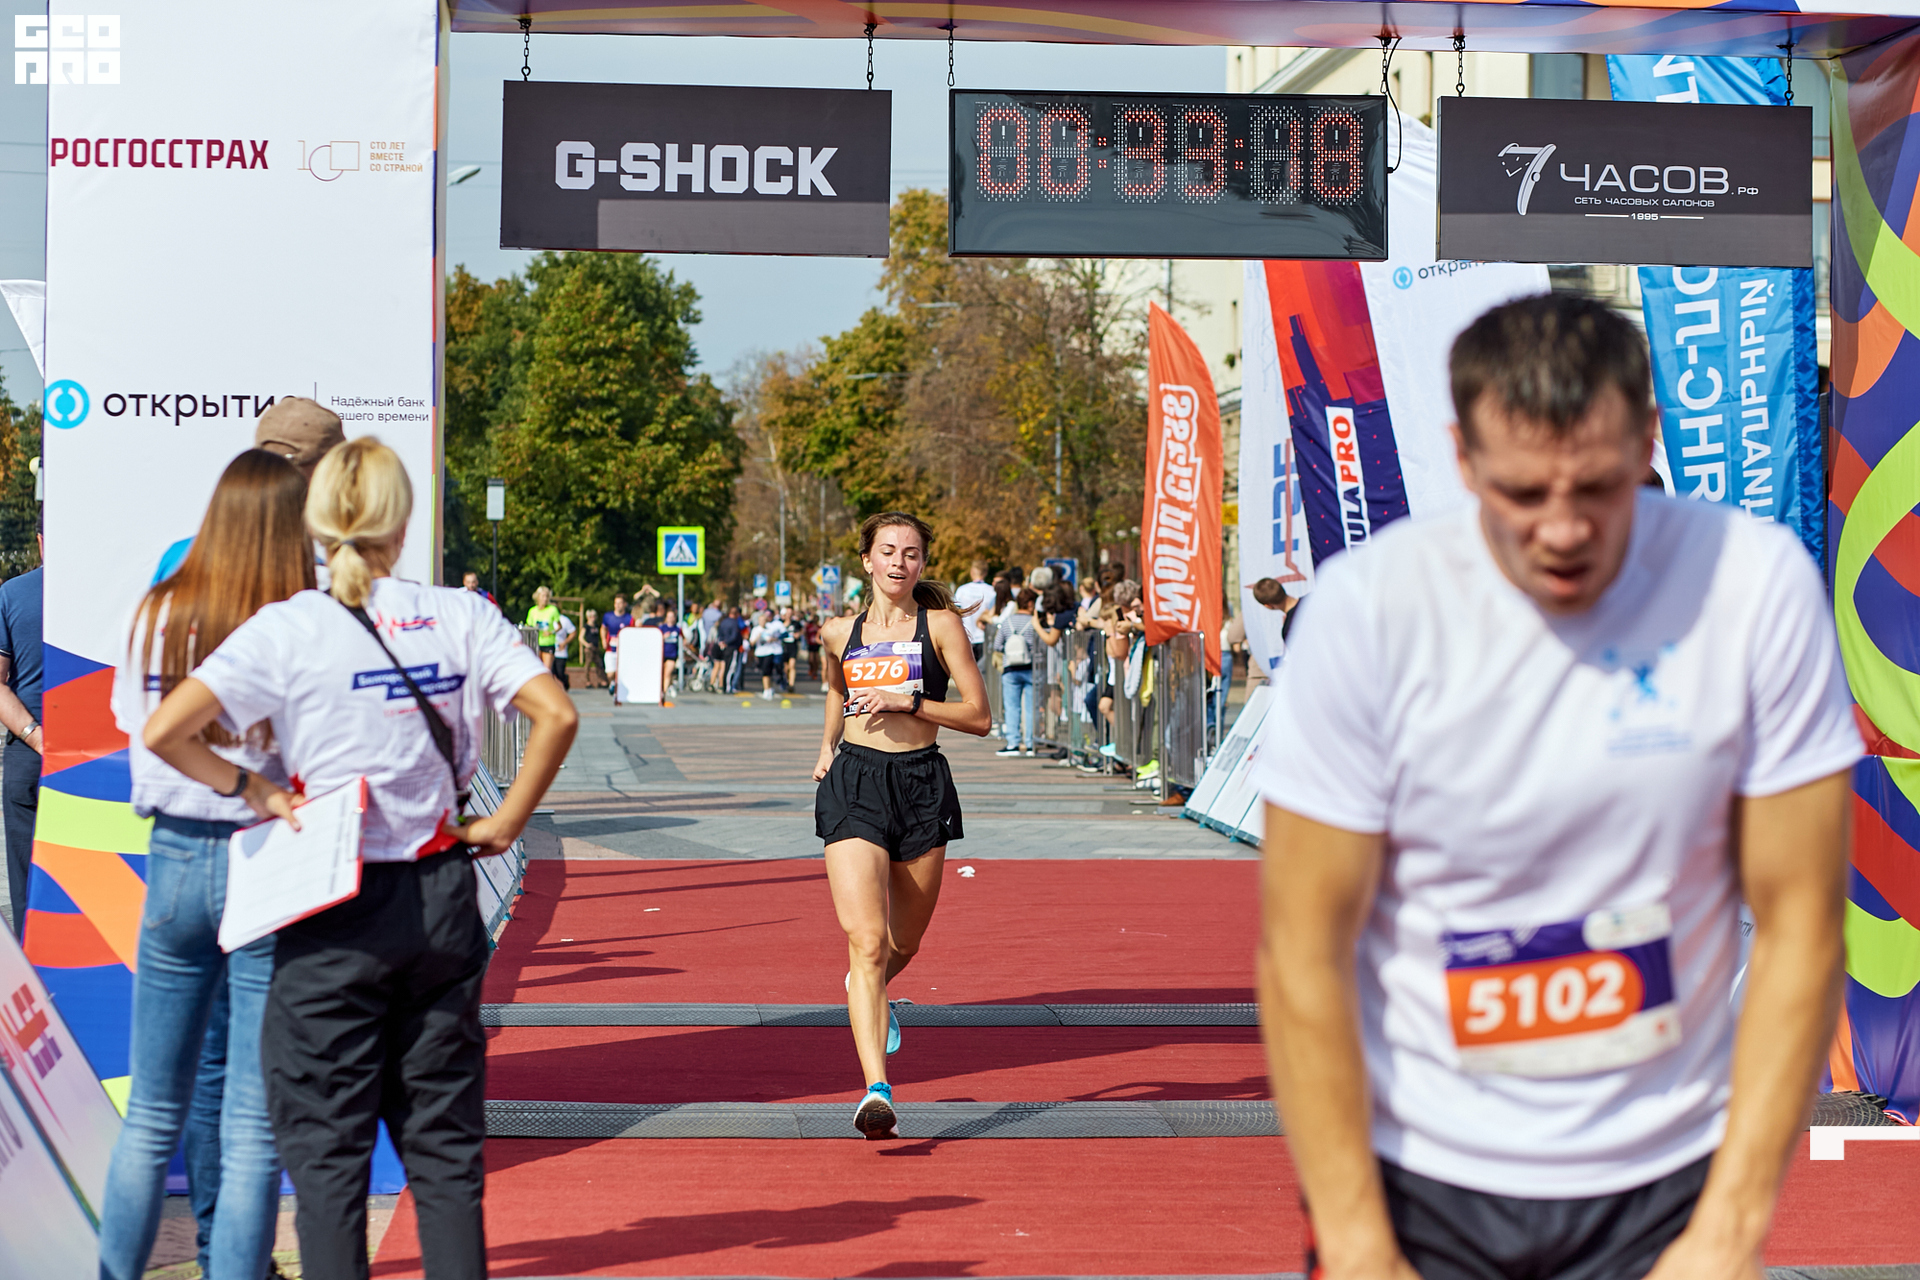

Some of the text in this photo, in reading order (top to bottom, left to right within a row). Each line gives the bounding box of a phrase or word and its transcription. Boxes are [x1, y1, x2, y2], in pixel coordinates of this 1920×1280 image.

[370, 141, 406, 150] СТО ЛЕТ
[50, 137, 270, 170] РОСГОССТРАХ
[370, 152, 404, 161] ВМЕСТЕ
[369, 163, 423, 172] СО СТРАНОЙ
[555, 140, 839, 196] G-SHOCK
[1574, 196, 1716, 208] СЕТЬ ЧАСОВЫХ САЛОНОВ
[1630, 212, 1659, 221] 1995
[331, 395, 425, 407] Надёжный банк
[103, 392, 296, 426] открыти
[338, 412, 429, 423] ашего времени
[1332, 414, 1368, 543] ULAPRO
[850, 659, 904, 682] 5276
[1464, 960, 1626, 1035] 5102
